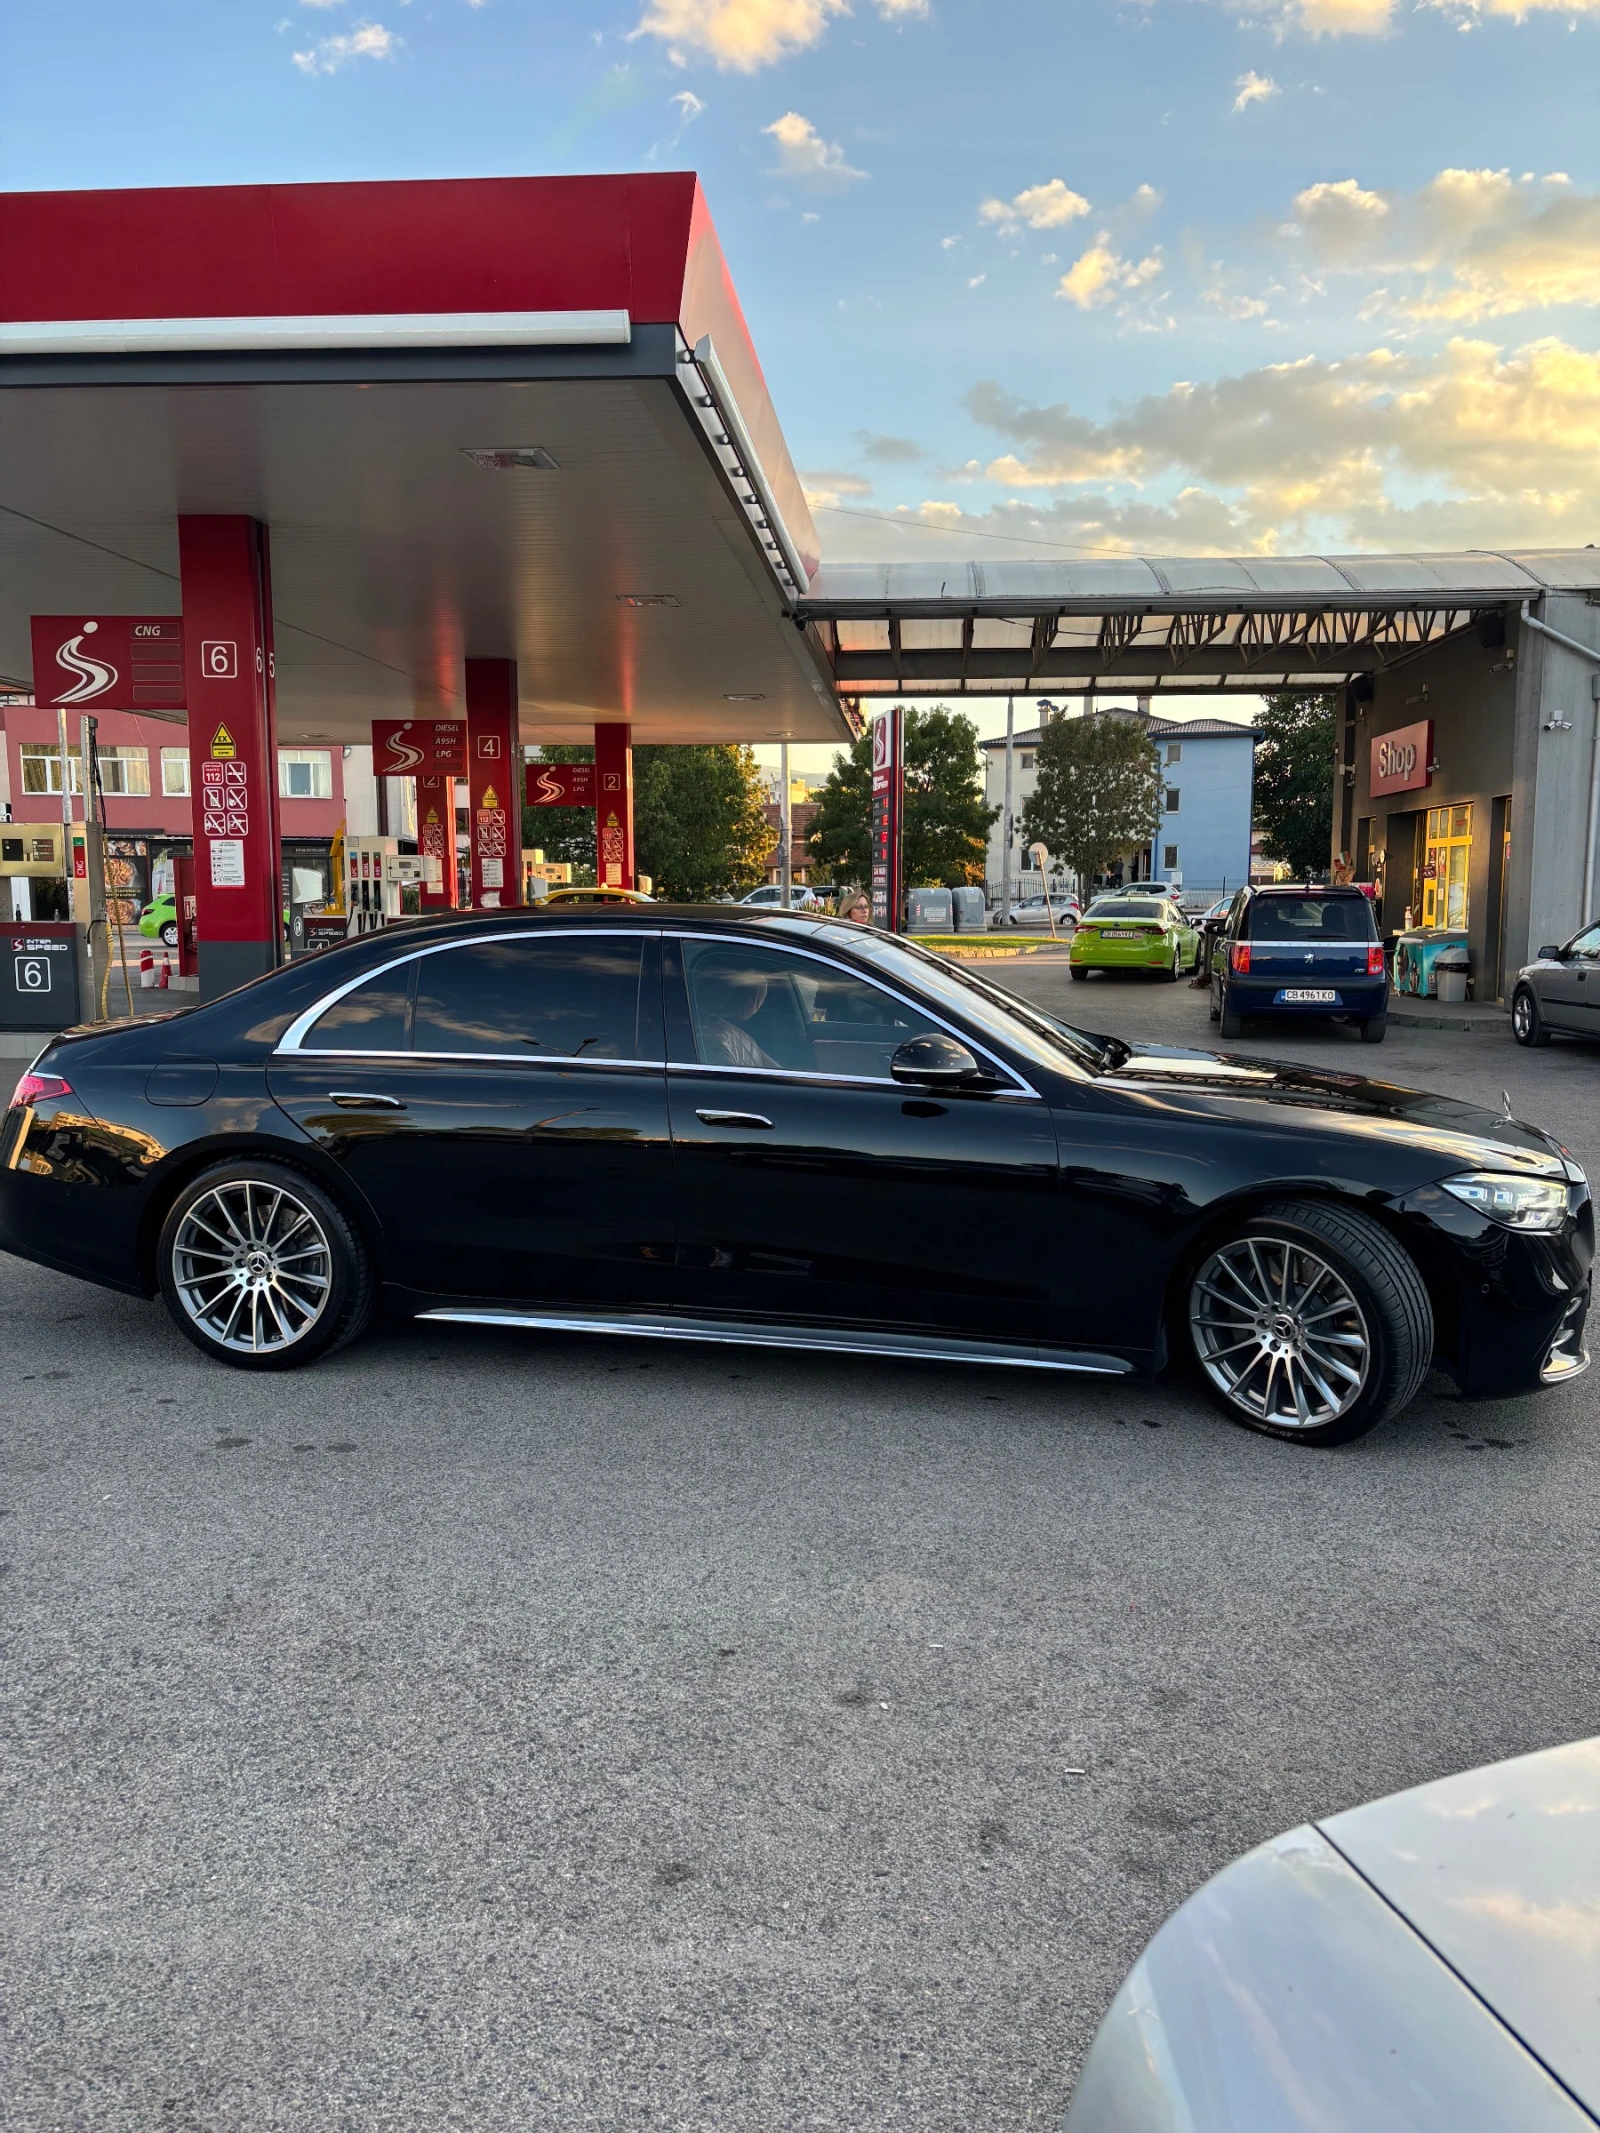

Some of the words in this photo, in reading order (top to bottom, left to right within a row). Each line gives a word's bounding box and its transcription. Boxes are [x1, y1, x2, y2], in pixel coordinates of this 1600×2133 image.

[135, 625, 160, 636] CNG
[211, 646, 228, 672] 6
[256, 647, 262, 673] 6
[269, 652, 276, 678] 5
[483, 739, 494, 756] 4
[1378, 740, 1416, 781] Shop
[206, 772, 220, 782] 112
[608, 776, 616, 788] 2
[76, 861, 84, 876] CNG
[24, 962, 42, 987] 6
[1286, 990, 1298, 999] CB
[1300, 991, 1320, 999] 4961
[1322, 991, 1334, 999] KO
